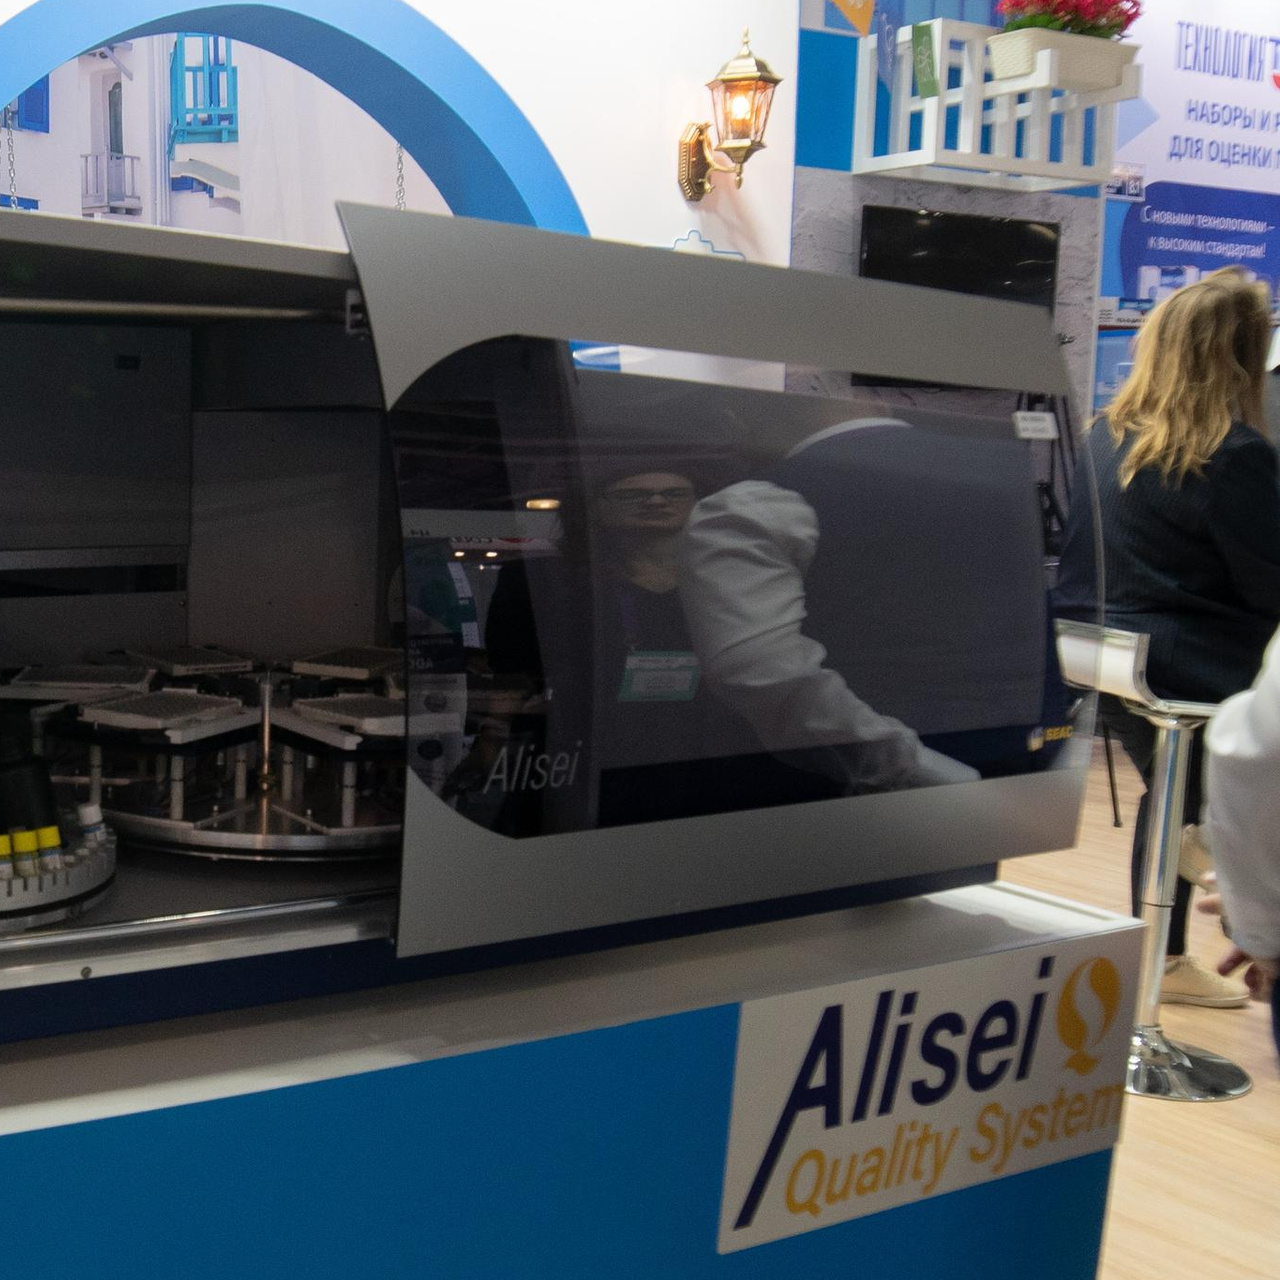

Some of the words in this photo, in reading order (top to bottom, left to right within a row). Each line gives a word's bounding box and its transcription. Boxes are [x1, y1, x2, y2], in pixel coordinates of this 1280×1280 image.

[1177, 20, 1266, 82] ТЕХНОЛОГИЯ
[1187, 99, 1256, 129] НАБОРЫ
[1260, 109, 1271, 132] И
[1169, 134, 1203, 162] ДЛЯ
[1209, 140, 1273, 169] ОЦЕНКИ
[1153, 210, 1195, 227] новыми
[1196, 215, 1267, 234] технологиями
[1158, 238, 1205, 253] высоким
[483, 739, 582, 795] Alisei
[733, 955, 1055, 1232] Alisei
[785, 1119, 961, 1217] Quality
